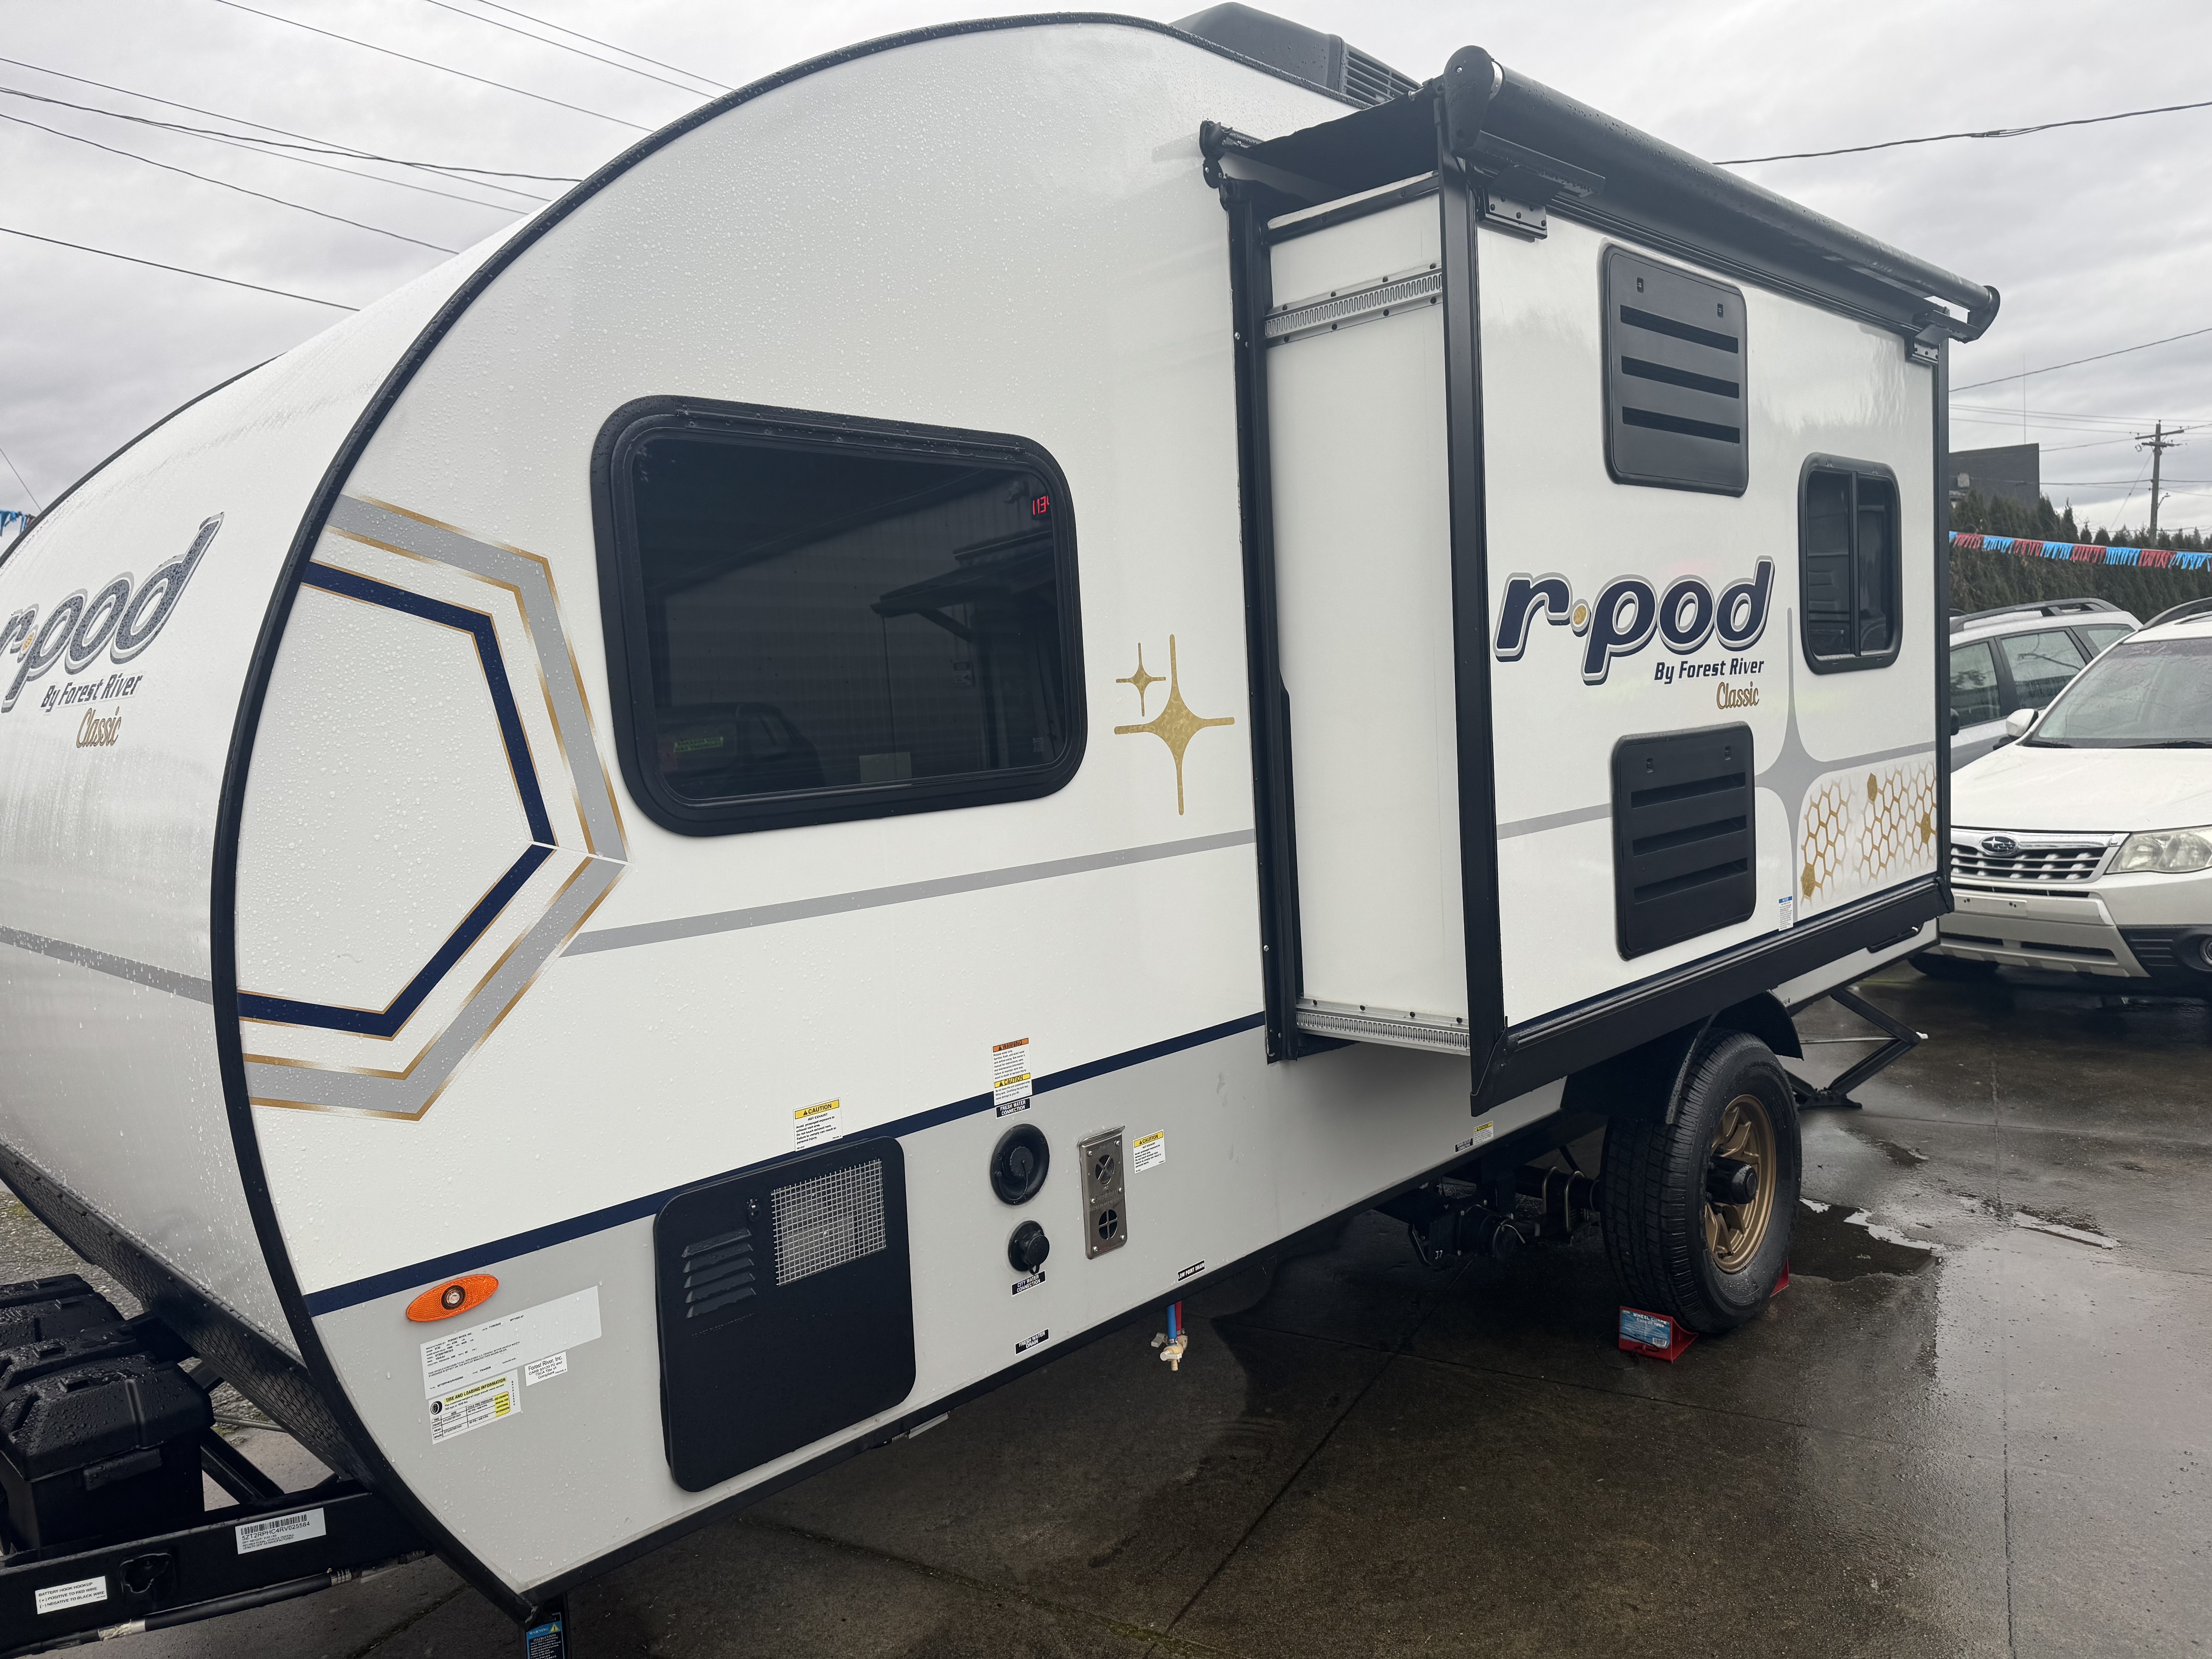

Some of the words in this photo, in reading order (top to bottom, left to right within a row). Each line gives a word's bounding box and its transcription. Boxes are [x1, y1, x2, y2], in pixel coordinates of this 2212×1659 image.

[1654, 662, 1674, 684] By
[1678, 659, 1726, 679] Forest
[1729, 658, 1765, 675] River
[41, 685, 58, 713] By
[58, 678, 103, 706] Forest
[101, 673, 143, 699] River
[1716, 681, 1759, 709] Classic
[76, 706, 122, 749] Classic
[1003, 1040, 1023, 1049] WARNING
[1004, 1075, 1023, 1085] CAUTION
[808, 1103, 831, 1114] CAUTION
[1001, 1105, 1025, 1116] CONNECTION
[1142, 1134, 1158, 1143] CAUTION
[1185, 1267, 1194, 1276] POINT
[1195, 1262, 1204, 1271] DRAIN
[1017, 1278, 1040, 1292] CONNECTION
[1027, 1274, 1039, 1283] WATER
[1019, 1338, 1032, 1348] FRESH
[1032, 1331, 1045, 1340] WATER
[1026, 1339, 1038, 1348] DRAIN
[528, 1363, 541, 1371] Forest
[464, 1387, 480, 1396] LOADING
[481, 1377, 505, 1389] INFORMATION
[242, 1521, 310, 1540] 5ZT2RPHC4RV025584
